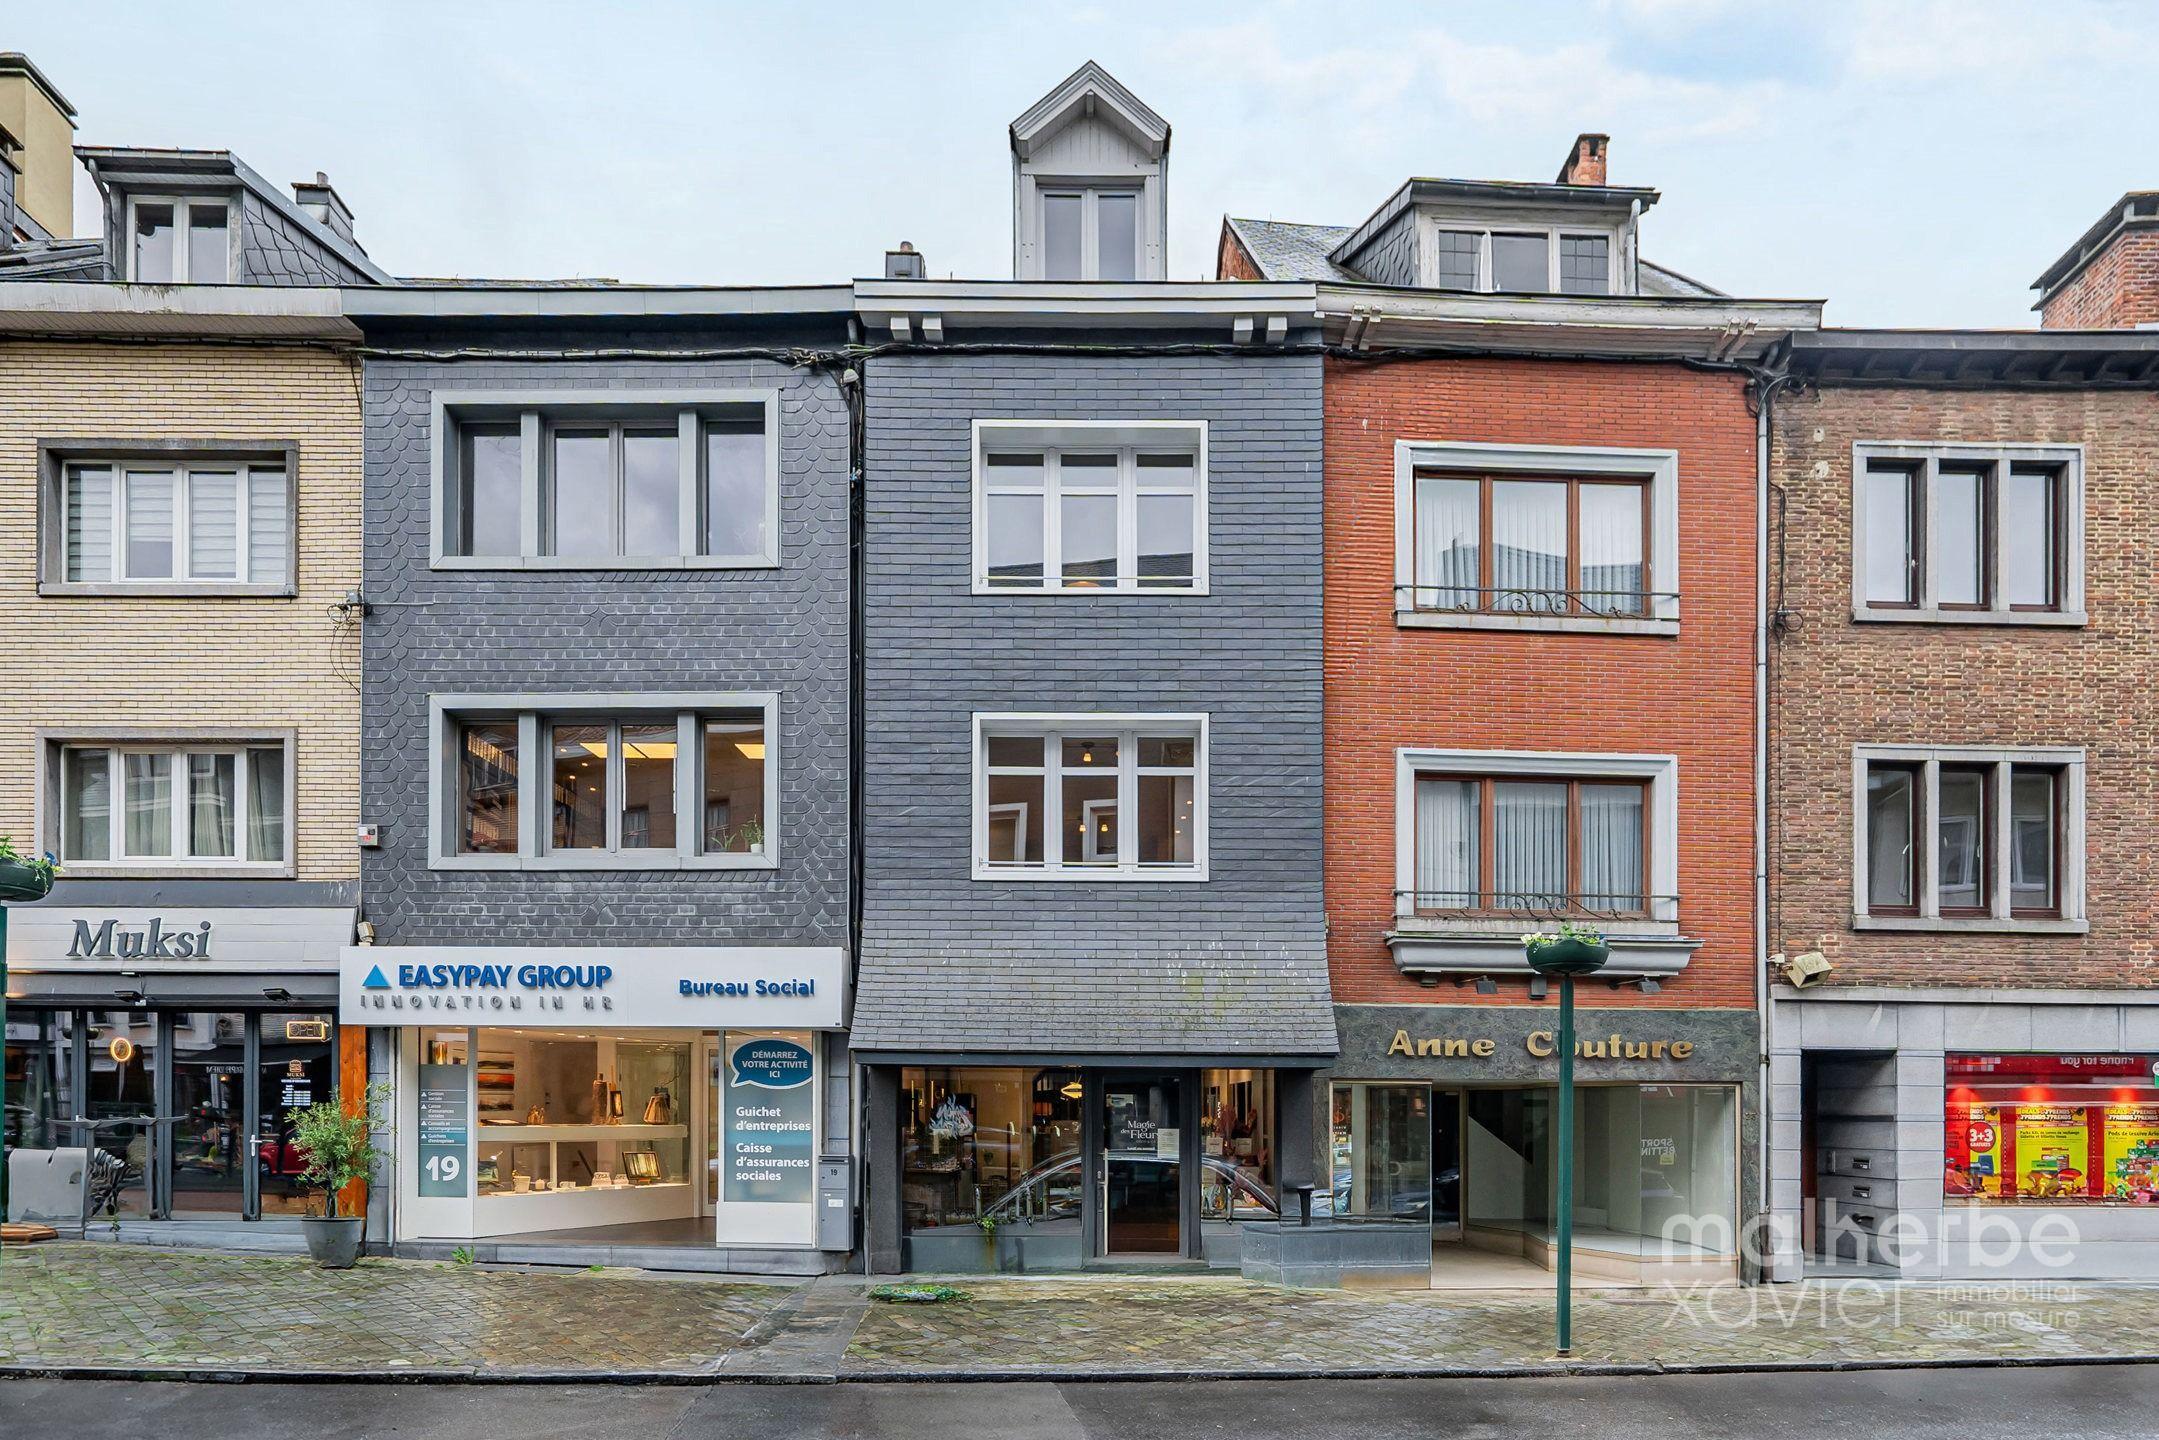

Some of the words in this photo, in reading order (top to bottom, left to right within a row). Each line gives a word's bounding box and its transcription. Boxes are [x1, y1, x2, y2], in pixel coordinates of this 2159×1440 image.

[65, 917, 212, 958] Muksi
[398, 964, 514, 989] EASYPAY
[517, 964, 613, 989] GROUP
[679, 979, 749, 996] Bureau
[755, 978, 815, 996] Social
[360, 995, 521, 1010] INNOVATION
[539, 995, 563, 1010] IN
[582, 995, 613, 1010] HR
[290, 1023, 321, 1037] OPEN
[1387, 1029, 1496, 1058] Anne
[752, 1049, 798, 1059] DÉMARREZ
[742, 1060, 769, 1068] VOTRE
[770, 1059, 808, 1068] ACTIVITÉ
[769, 1070, 781, 1078] ICI
[736, 1106, 782, 1117] Guichet
[736, 1120, 811, 1133] d'entreprises
[1127, 1120, 1156, 1132] Magie
[1969, 1128, 1994, 1142] 3+3
[736, 1142, 773, 1153] Caisse
[736, 1156, 810, 1167] d'assurances
[425, 1155, 460, 1181] 19
[830, 1168, 838, 1176] 19
[736, 1170, 782, 1181] sociales
